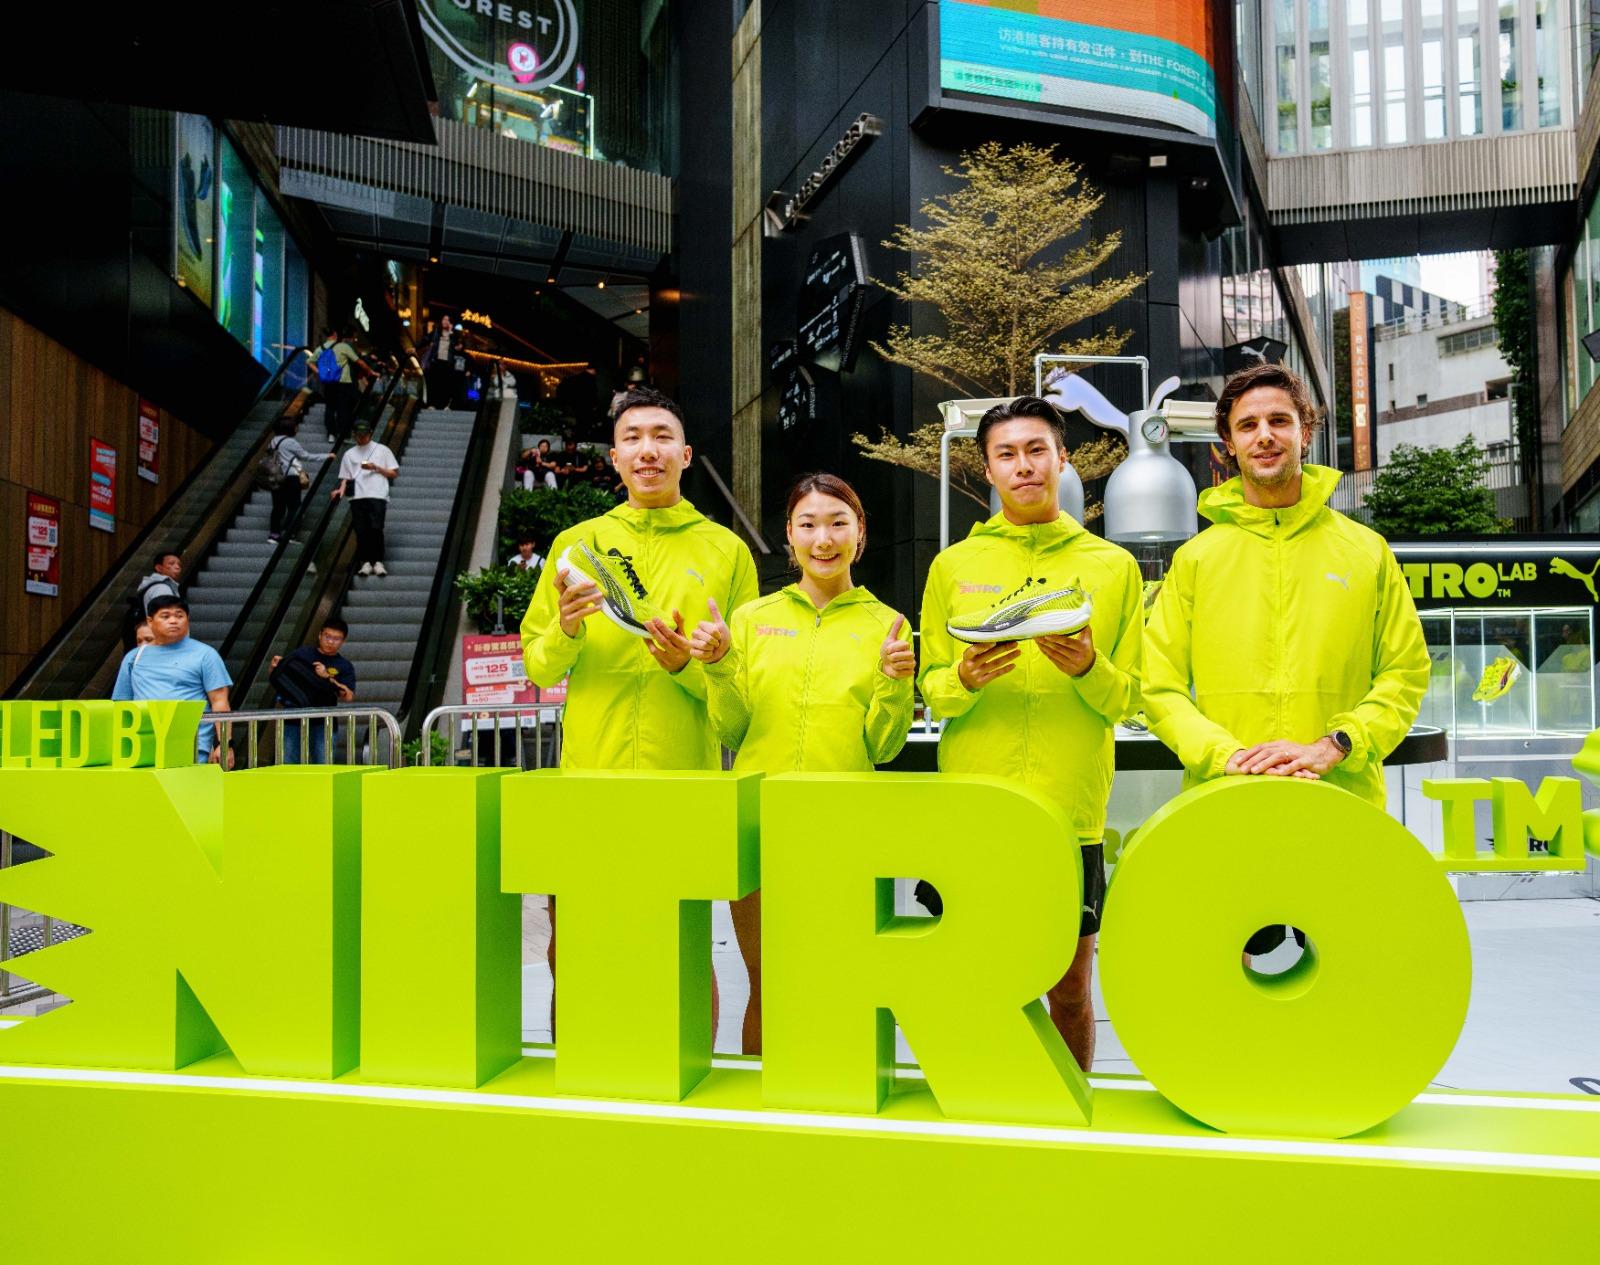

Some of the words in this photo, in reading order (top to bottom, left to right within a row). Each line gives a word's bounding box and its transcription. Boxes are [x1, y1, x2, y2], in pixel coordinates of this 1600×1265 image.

[1400, 562, 1498, 598] TRO
[1497, 562, 1537, 581] LAB
[1497, 588, 1511, 598] TM
[486, 663, 508, 673] 125
[112, 701, 195, 769] BY
[1423, 776, 1583, 860] TM
[0, 765, 1472, 1138] NITRO
